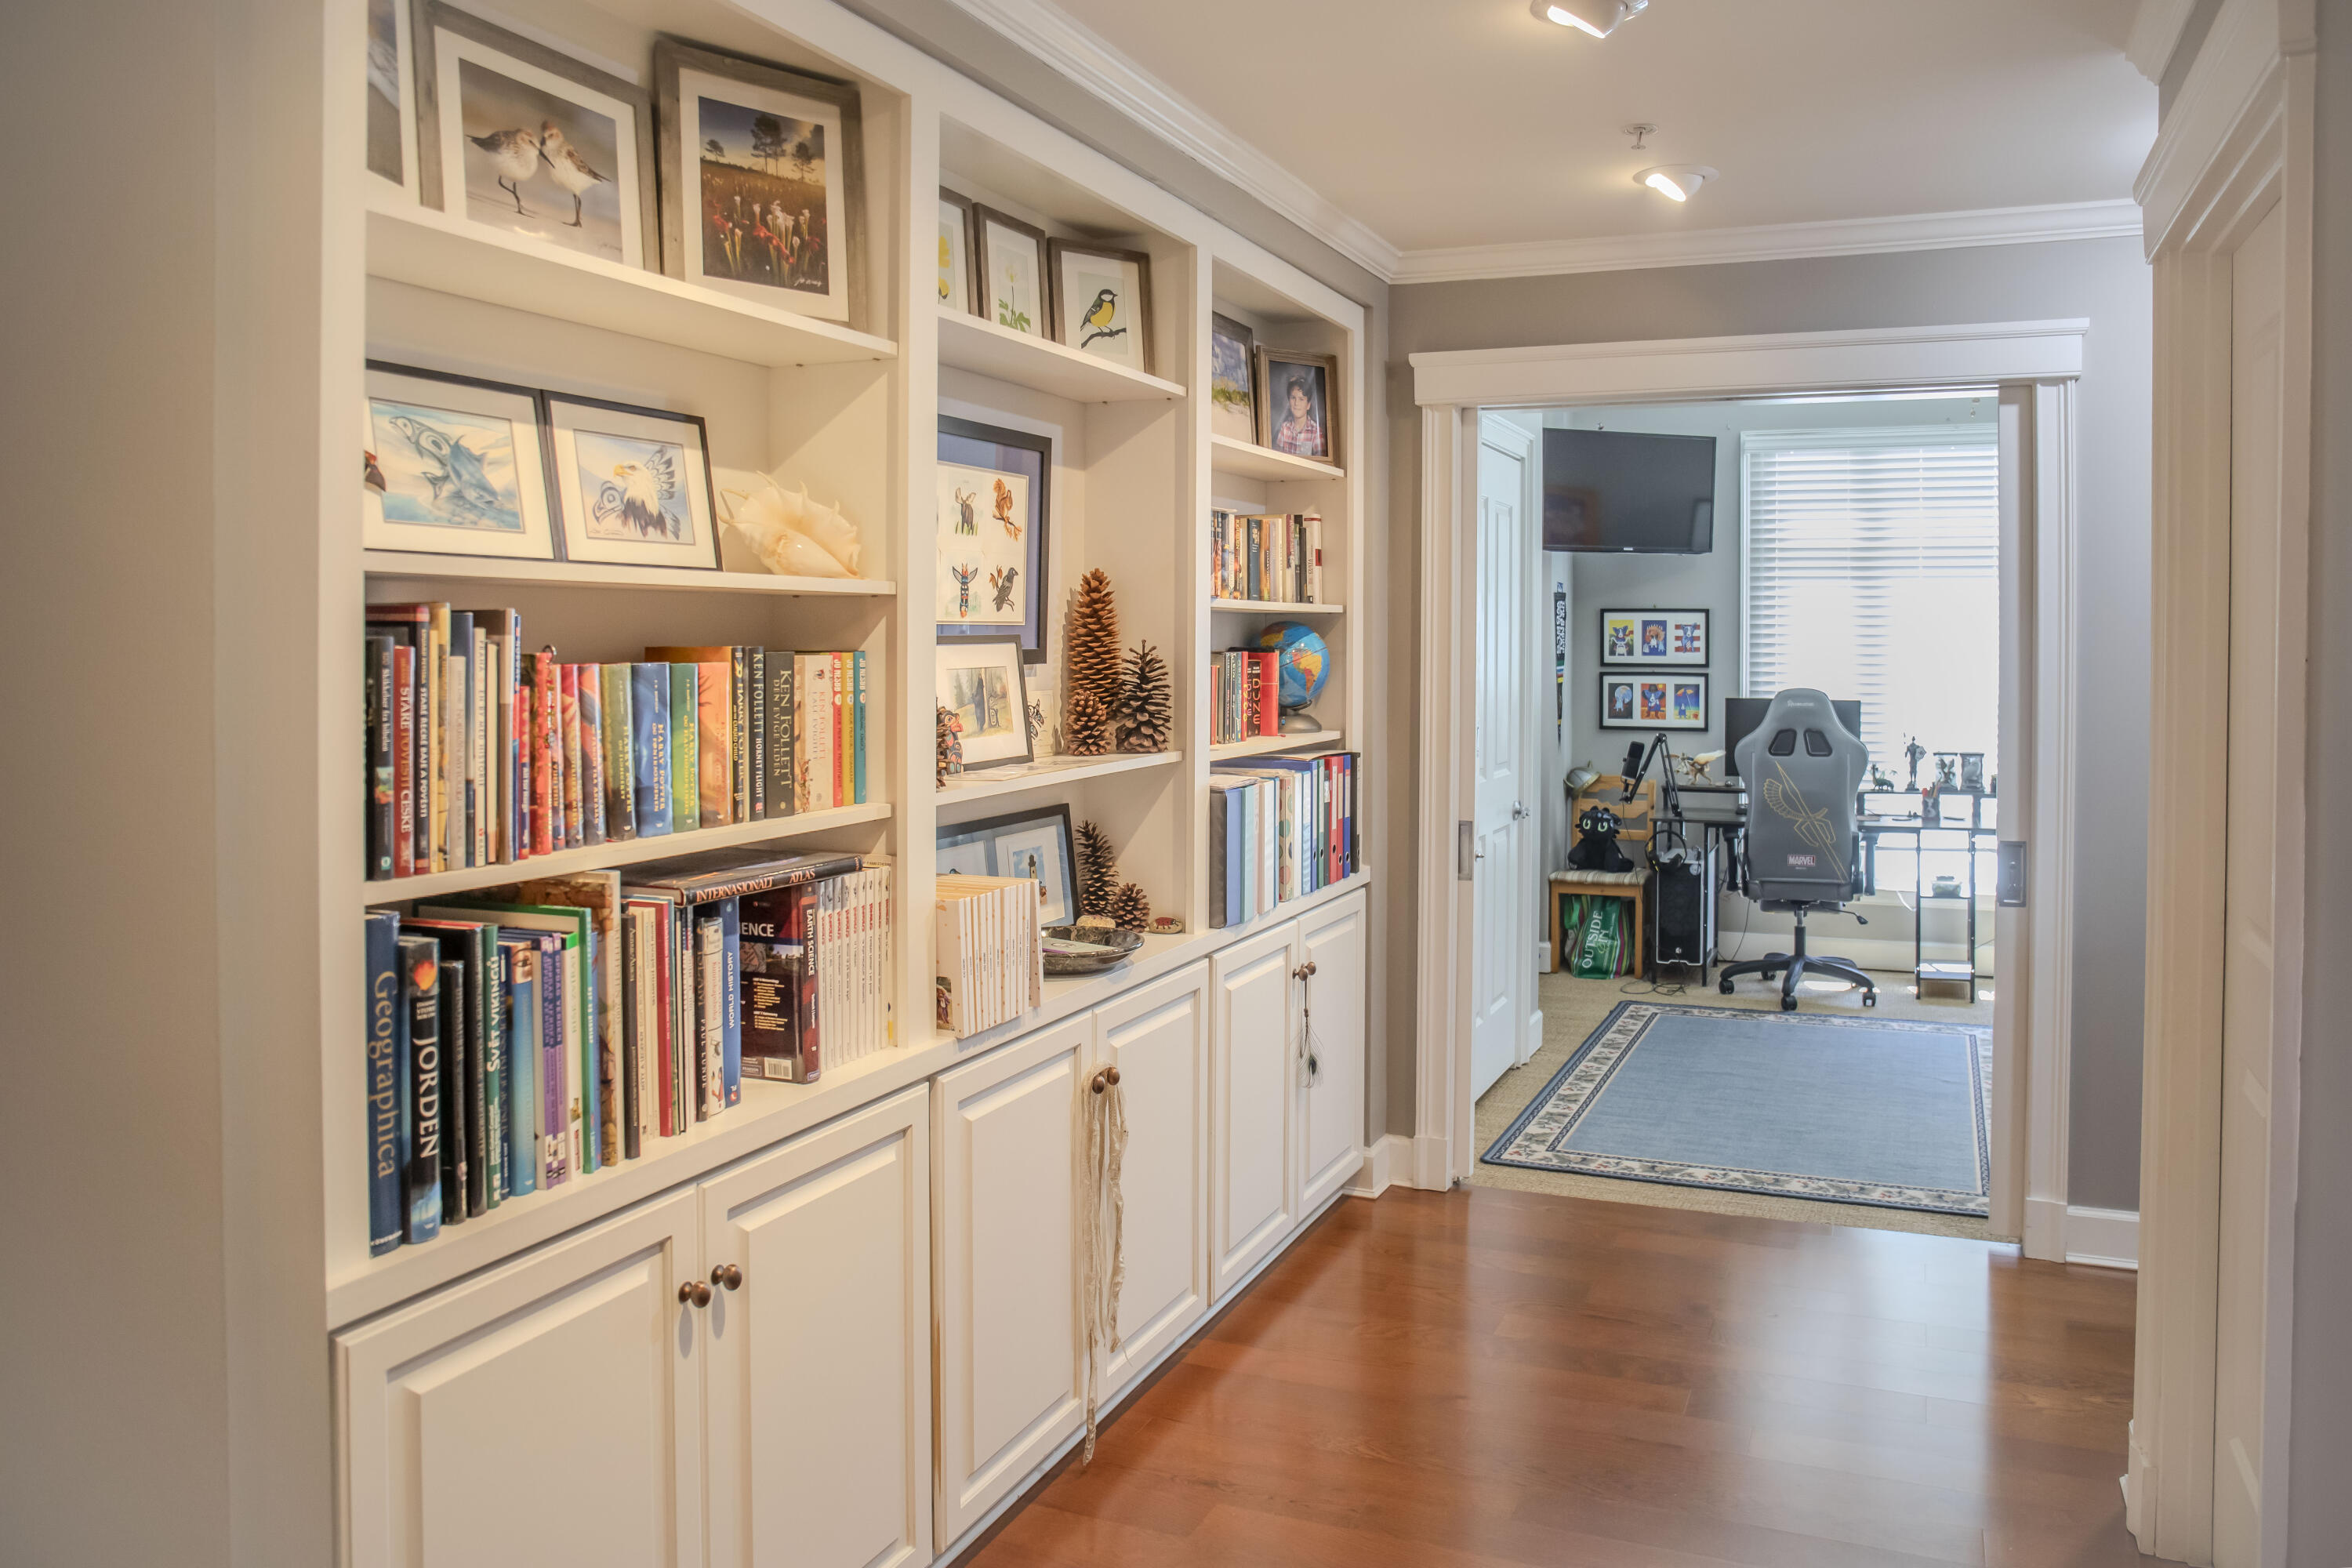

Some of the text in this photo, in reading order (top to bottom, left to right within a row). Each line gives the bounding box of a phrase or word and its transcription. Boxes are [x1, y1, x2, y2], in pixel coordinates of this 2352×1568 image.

[833, 659, 842, 669] JO
[846, 659, 854, 668] JO
[858, 658, 866, 668] JO
[753, 653, 764, 734] KEN FOLLETT
[772, 679, 781, 702] DEN
[779, 669, 792, 789] KEN FOLLETT
[818, 716, 827, 760] FOLLETT
[789, 869, 817, 884] ATLAS
[1788, 855, 1814, 866] MARVEL
[806, 909, 816, 976] EARTH SCIENCE
[1581, 909, 1603, 969] OUTSIDE
[367, 971, 401, 1179] Geographica
[412, 1036, 440, 1159] JORDEN
